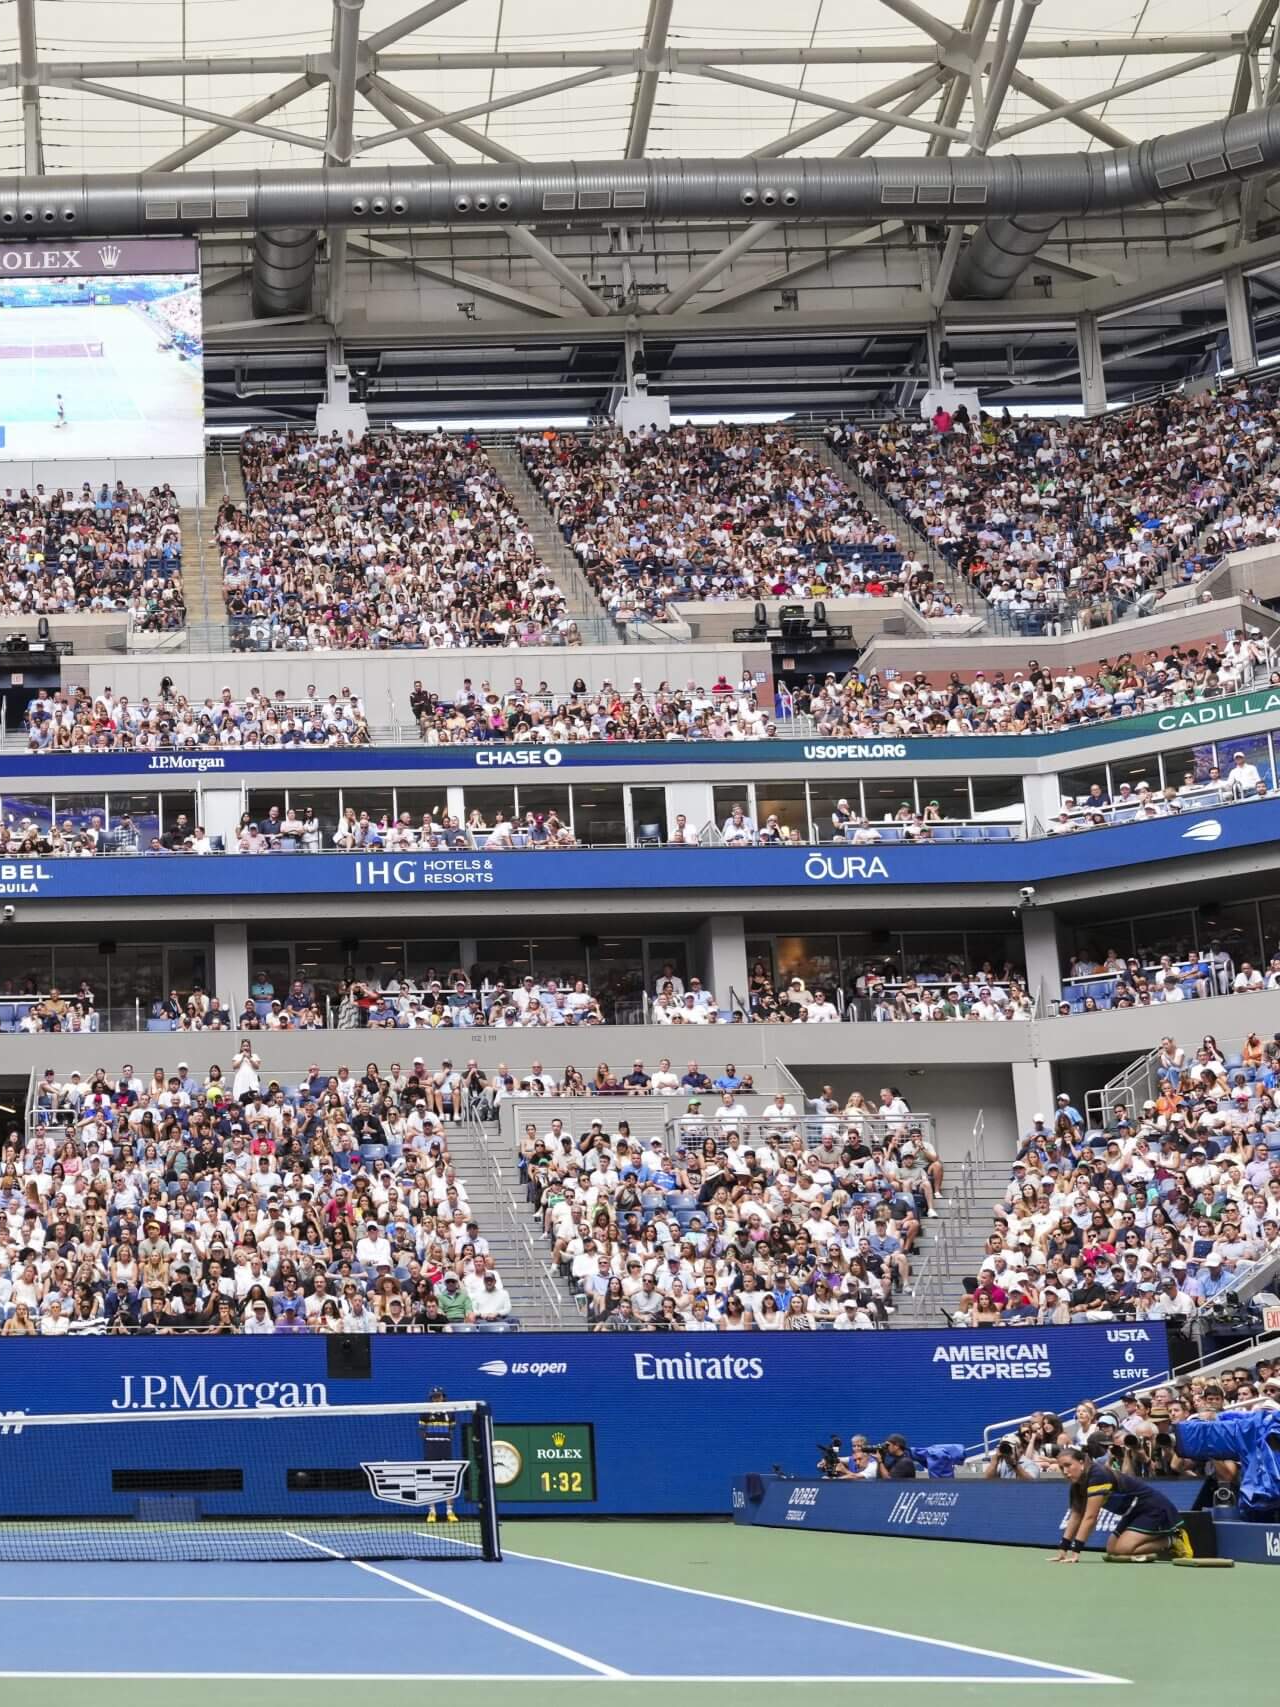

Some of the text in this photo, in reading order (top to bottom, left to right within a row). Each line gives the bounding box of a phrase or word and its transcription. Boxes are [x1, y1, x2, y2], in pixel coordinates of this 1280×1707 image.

[1158, 695, 1280, 730] CADILLA
[476, 750, 542, 765] CHASE
[803, 743, 907, 759] USOPEN.ORG
[148, 756, 225, 771] J.P.Morgan
[355, 859, 493, 885] IHG HOTELS &
[424, 872, 494, 884] RESORTS
[1267, 1311, 1280, 1329] EXI
[1106, 1328, 1150, 1342] USTA
[932, 1343, 1049, 1362] AMERICAN
[1124, 1348, 1135, 1363] 6
[511, 1361, 567, 1376] us open
[633, 1351, 764, 1381] Emirates
[950, 1361, 1052, 1380] EXPRESS
[1112, 1368, 1150, 1379] SERVE
[111, 1374, 331, 1411] J.P.Morgan
[537, 1448, 583, 1459] ROLEX
[541, 1472, 582, 1492] 1:32
[888, 1491, 926, 1525] IHG
